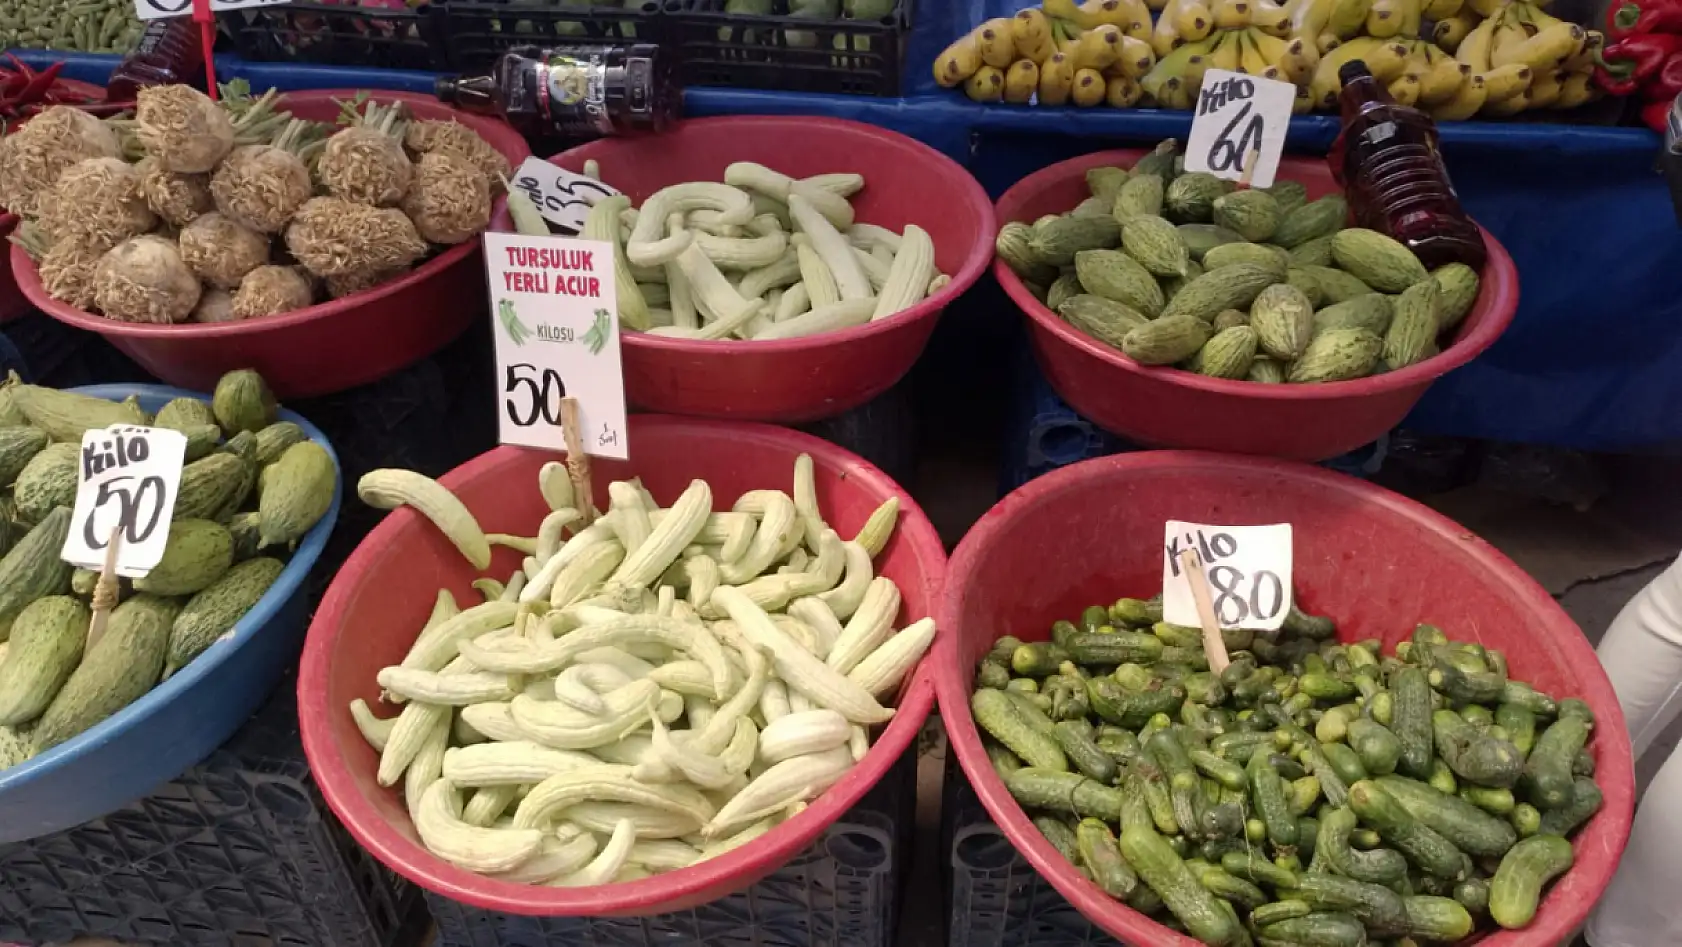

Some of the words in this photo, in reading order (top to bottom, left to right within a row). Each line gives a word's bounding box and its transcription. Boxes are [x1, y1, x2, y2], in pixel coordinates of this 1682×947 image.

[1207, 101, 1264, 172] 60
[555, 275, 601, 298] ACUR
[506, 363, 566, 427] 50
[84, 475, 166, 550] 50
[1208, 565, 1284, 625] 80
